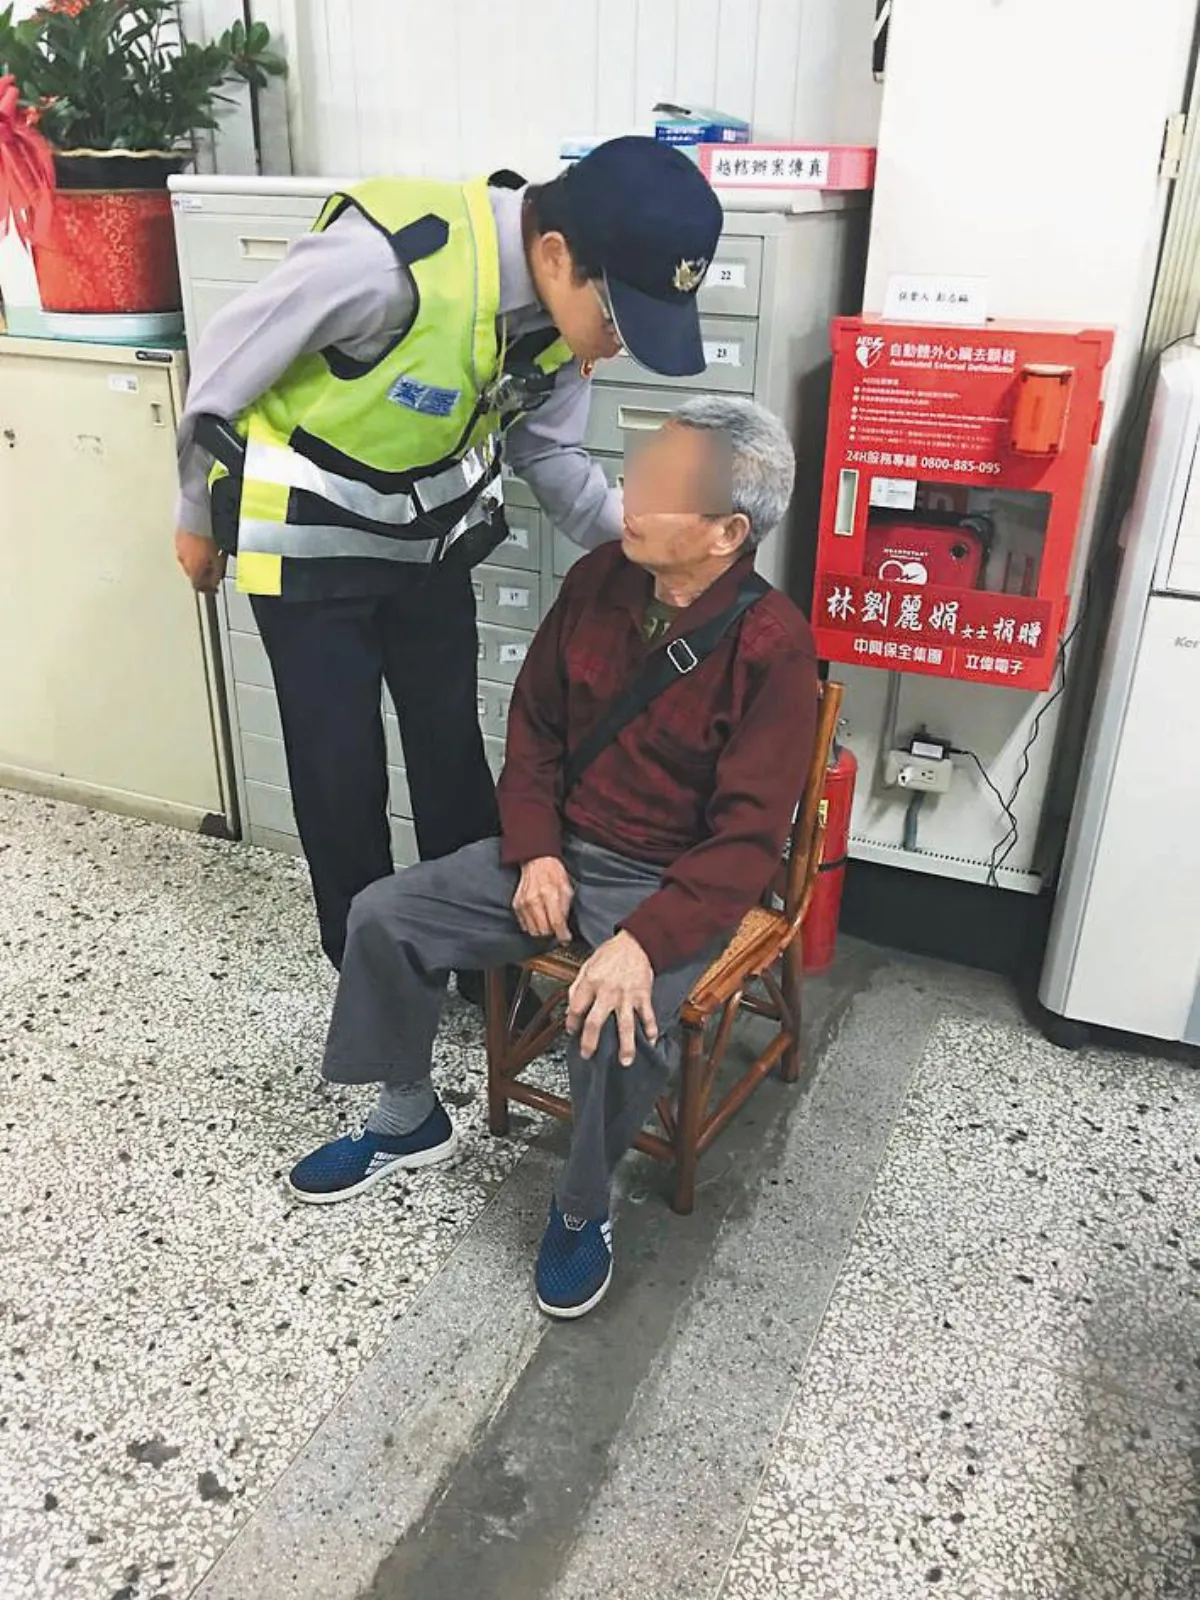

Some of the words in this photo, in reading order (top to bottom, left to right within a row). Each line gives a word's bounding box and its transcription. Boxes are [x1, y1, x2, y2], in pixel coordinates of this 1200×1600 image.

[715, 157, 823, 178] 越轄辦案傳真
[720, 270, 732, 281] 22
[716, 347, 728, 359] 23
[846, 450, 918, 469] 24H服務專線
[921, 456, 1001, 475] 0800-885-095
[853, 637, 944, 665] 中興保全集團
[964, 654, 1024, 676] 立偉電子
